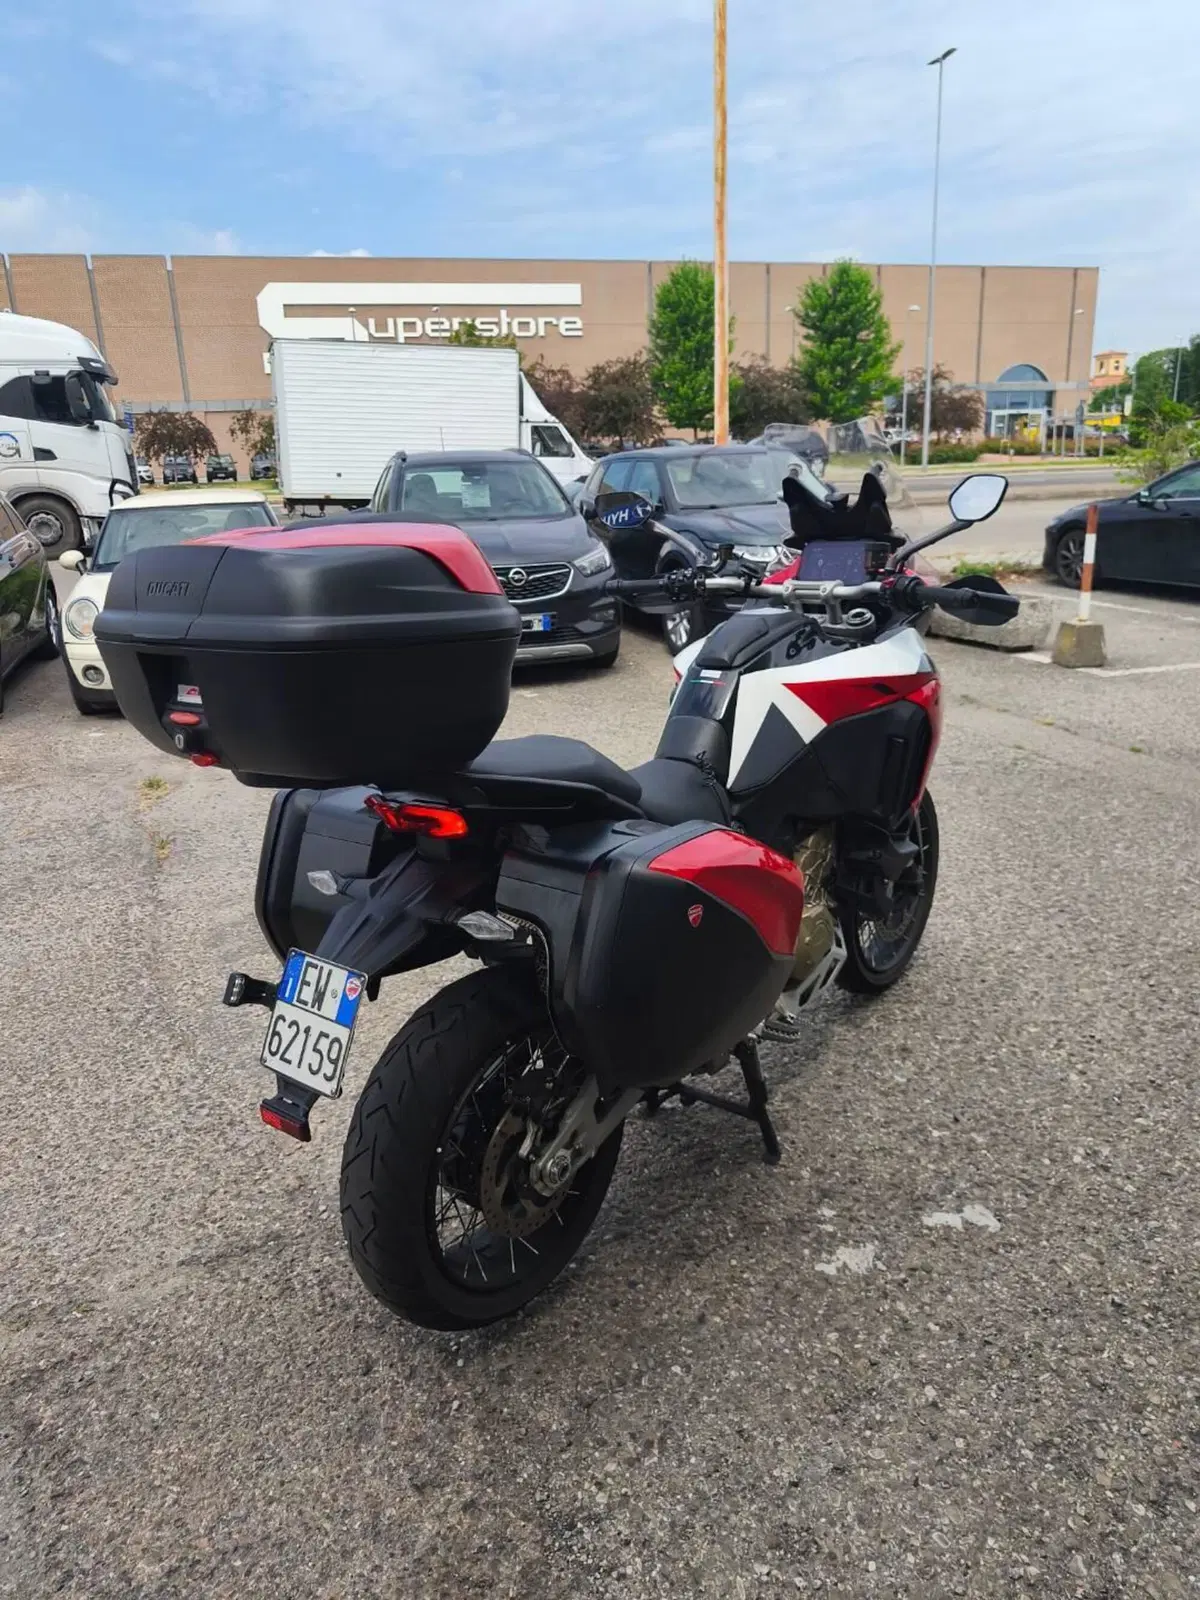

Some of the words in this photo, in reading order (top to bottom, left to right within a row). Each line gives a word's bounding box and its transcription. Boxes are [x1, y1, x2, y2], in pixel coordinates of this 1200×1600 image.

[146, 581, 190, 597] DUCATI
[296, 960, 333, 1012] EW
[268, 1014, 343, 1082] 62159
